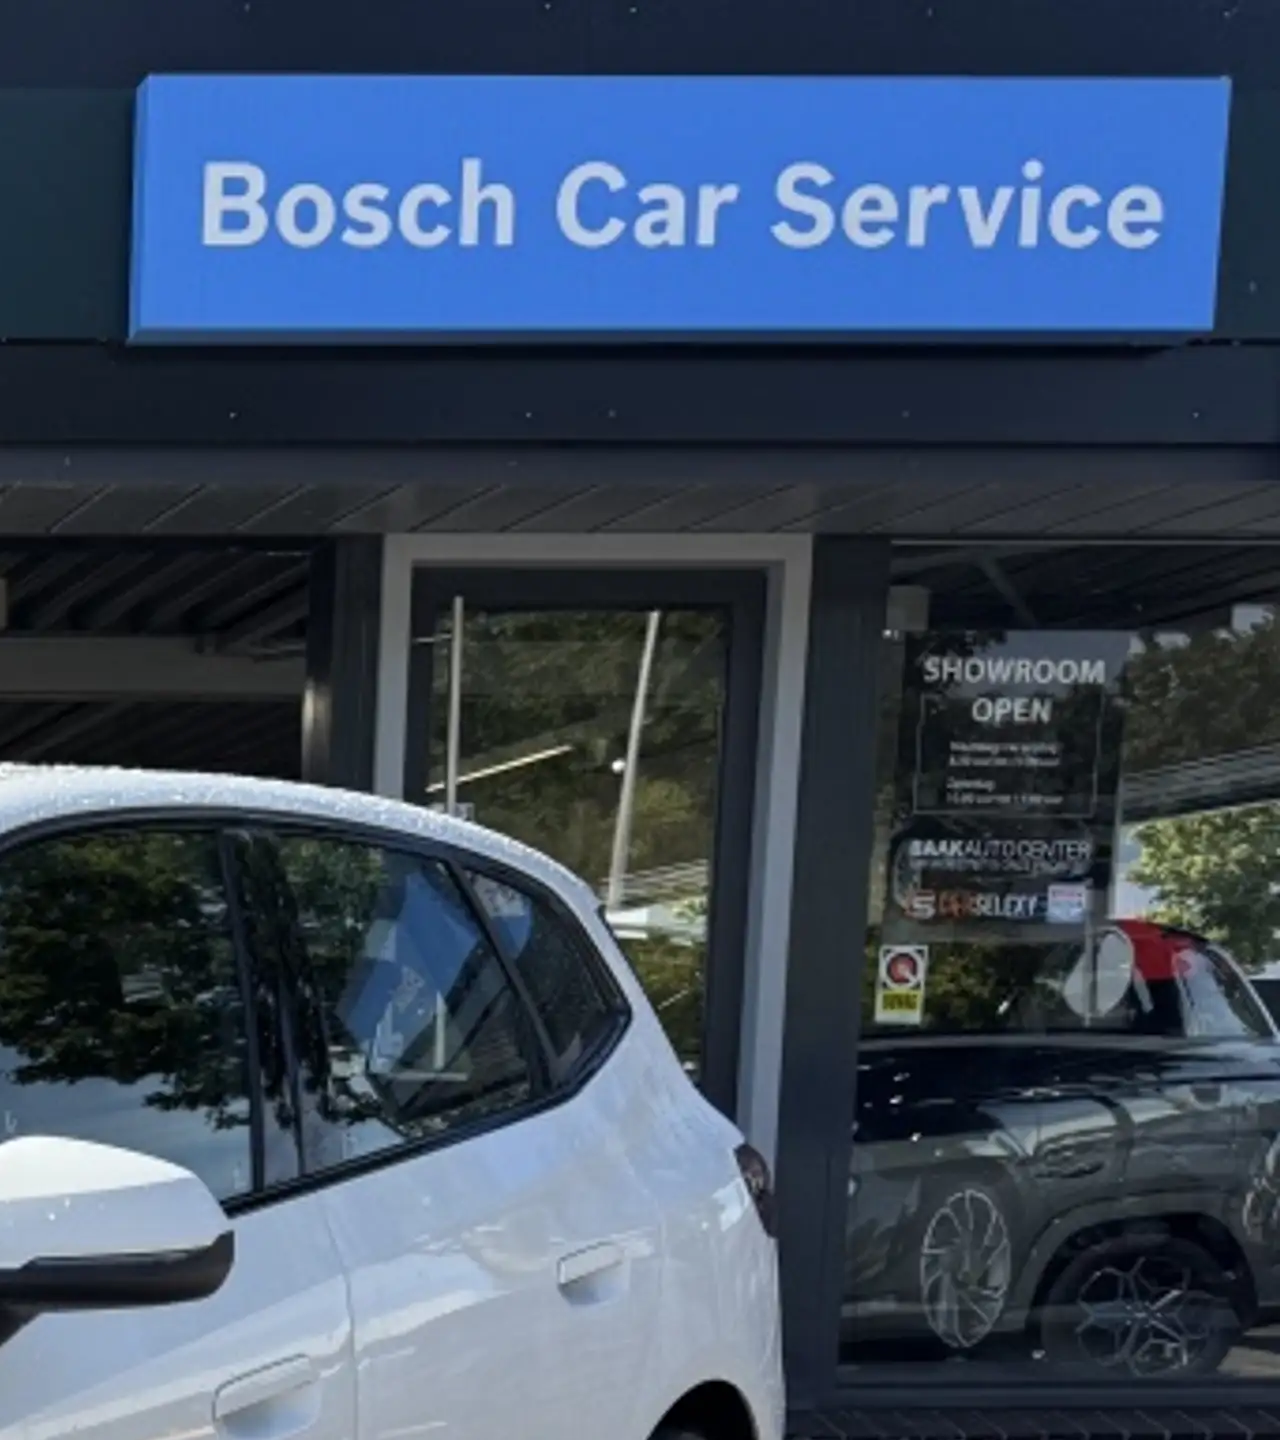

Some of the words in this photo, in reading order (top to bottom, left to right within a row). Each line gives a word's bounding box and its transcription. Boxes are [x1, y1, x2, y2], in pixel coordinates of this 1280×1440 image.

[201, 156, 516, 248] Bosch
[555, 160, 739, 249] Car
[769, 157, 1165, 249] Service
[922, 656, 1106, 684] SHOWROOM
[971, 697, 1053, 724] OPEN
